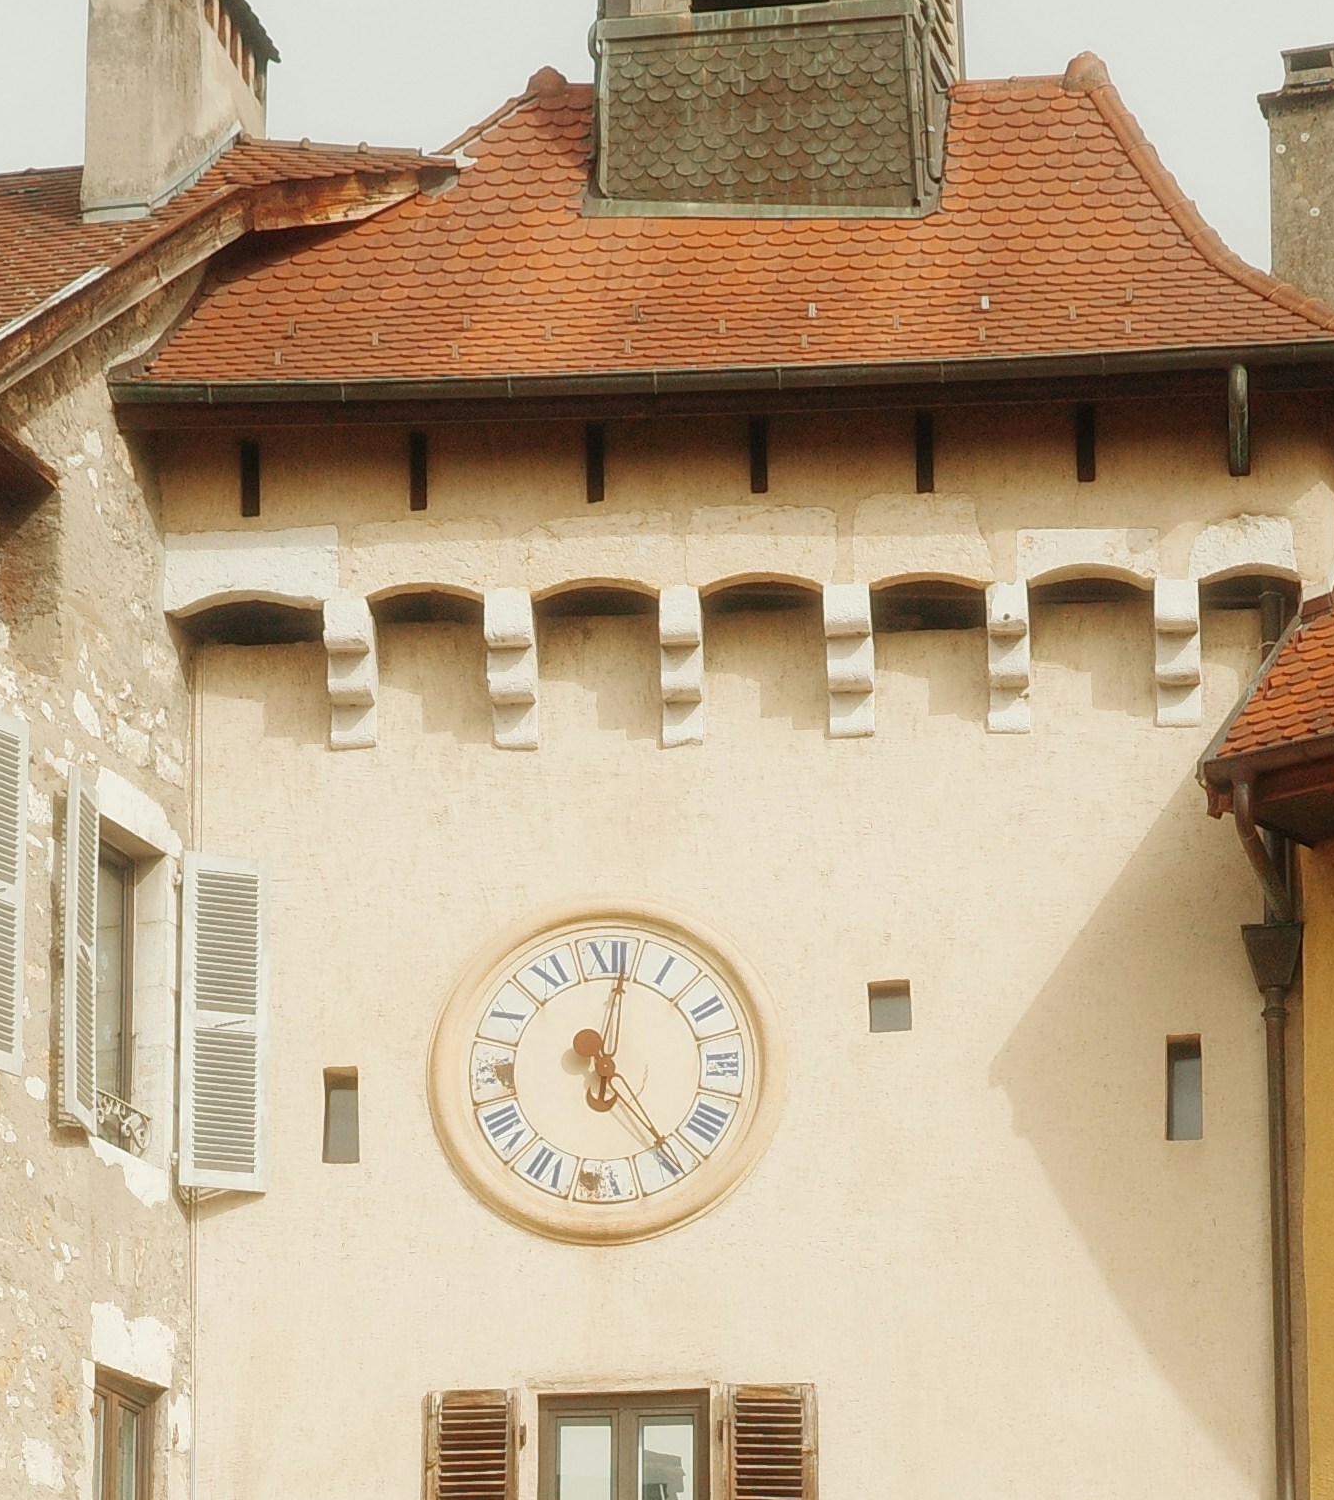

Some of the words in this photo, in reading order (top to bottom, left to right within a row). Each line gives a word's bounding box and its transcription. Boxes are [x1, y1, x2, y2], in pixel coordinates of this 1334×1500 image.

[528, 953, 572, 996] XI
[586, 940, 630, 976] XII
[652, 954, 677, 987] I
[487, 1000, 528, 1033] X
[689, 994, 726, 1024] II
[482, 1102, 528, 1154] VIII
[524, 1144, 565, 1191] VII
